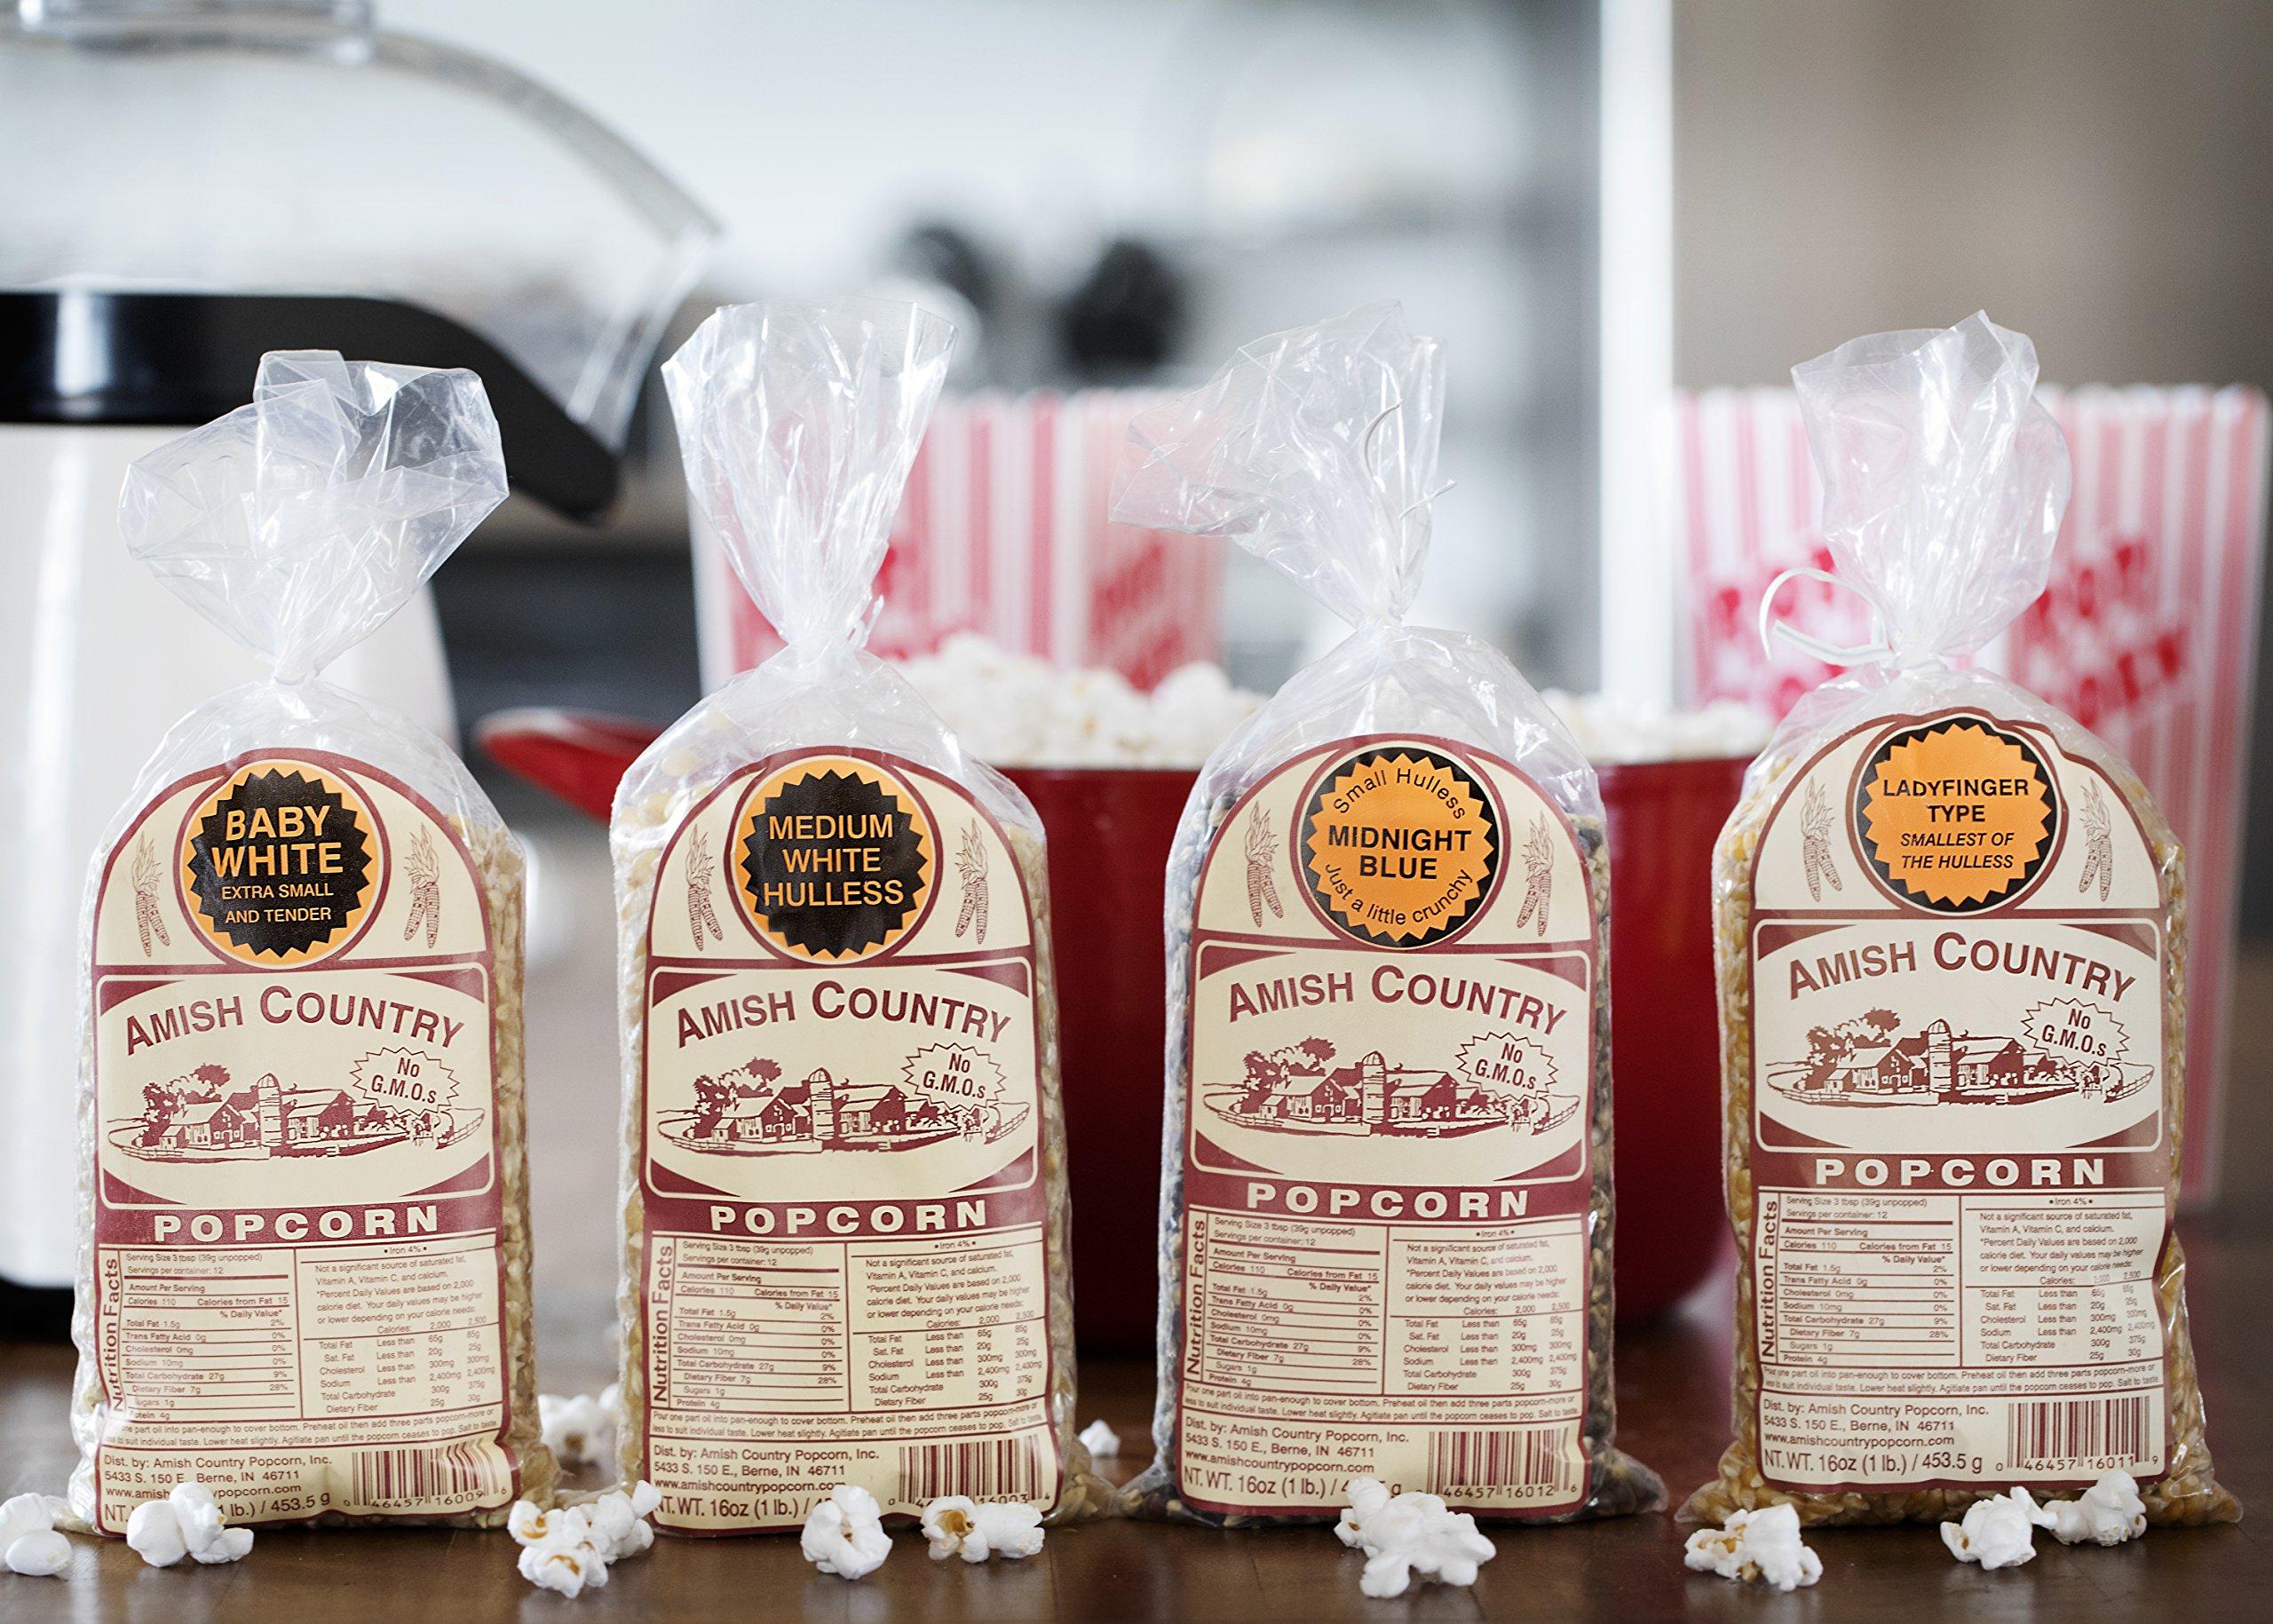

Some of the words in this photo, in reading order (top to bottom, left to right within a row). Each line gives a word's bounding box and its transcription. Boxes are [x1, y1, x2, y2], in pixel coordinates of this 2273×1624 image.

[1334, 770, 1386, 813] Small
[1397, 768, 1465, 820] Hulless
[1883, 779, 2028, 796] LADYFINGER
[226, 805, 330, 841] BABY
[1927, 804, 1985, 822] TYPE
[769, 814, 893, 839] MEDIUM
[1328, 825, 1471, 852] MIDNIGHT
[1900, 832, 1987, 847] SMALLEST
[1992, 832, 2015, 846] OF
[211, 842, 344, 877] WHITE
[782, 848, 881, 873] WHITE
[1359, 855, 1437, 879] BLUE
[1902, 855, 1934, 869] THE
[1938, 854, 2014, 869] HULLESS
[223, 885, 274, 900] EXTRA
[279, 883, 334, 898] SMALL
[764, 880, 904, 907] HULLESS
[1326, 864, 1353, 900] Just
[1351, 899, 1363, 912] a
[1367, 904, 1406, 924] little
[1413, 869, 1473, 923] crunchy
[226, 910, 259, 923] AND
[264, 907, 331, 923] TENDER
[1790, 940, 1916, 1001] AMISH
[1934, 932, 2136, 1002] COUNTRY
[1230, 971, 1353, 1023] AMISH
[1372, 965, 1567, 1035] COUNTRY
[126, 995, 243, 1056] AMISH
[260, 986, 464, 1049] COUNTRY
[678, 990, 796, 1049] AMISH
[812, 980, 1011, 1043] COUNTRY
[2068, 1009, 2091, 1030] No
[1501, 1042, 1523, 1064] No
[2042, 1026, 2107, 1058] G.M.O.s
[397, 1058, 419, 1078] No
[949, 1053, 970, 1073] No
[1476, 1059, 1536, 1089] G.M.O.s
[371, 1075, 437, 1105] G.M.O.s
[923, 1071, 986, 1099] G.M.O.s
[1816, 1158, 2104, 1185] POPCORN
[1247, 1183, 1528, 1217] POPCORN
[154, 1205, 438, 1241] POPCORN
[710, 1200, 986, 1234] POPCORN
[2083, 1224, 2114, 1233] calcium.
[1759, 1200, 1777, 1259] Facts
[126, 1254, 154, 1264] Serving
[178, 1254, 195, 1264] tbsp
[199, 1254, 216, 1263] (39g
[218, 1253, 262, 1263] unpopped)
[1190, 1220, 1205, 1279] Facts
[652, 1246, 672, 1303] Facts
[104, 1259, 120, 1316] Facts
[1761, 1265, 1775, 1357] Nutrition
[926, 1333, 943, 1342] Less
[1187, 1285, 1203, 1374] Nutrition
[1211, 1335, 1228, 1343] Total
[1232, 1337, 1287, 1350] Carbohydrate
[1293, 1343, 1309, 1351] 27g
[104, 1322, 123, 1412] Nutrition
[653, 1310, 668, 1402] Nutrition
[1764, 1398, 1784, 1411] Dist.
[1788, 1402, 1804, 1415] by:
[1809, 1404, 1846, 1415] Amish
[1850, 1405, 1900, 1418] Country
[1905, 1405, 1961, 1417] Popcorn,
[1967, 1405, 1989, 1415] Inc.
[1186, 1416, 1206, 1430] Dist.
[1210, 1421, 1226, 1434] by:
[1231, 1424, 1268, 1438] Amish
[1272, 1427, 1320, 1442] Country
[1327, 1430, 1382, 1443] Popcorn,
[1387, 1432, 1409, 1442] Inc.
[1763, 1415, 1786, 1428] 5433
[1790, 1419, 1801, 1430] S.
[1806, 1420, 1826, 1430] 150
[1850, 1421, 1891, 1433] Berne,
[1896, 1421, 1908, 1431] IN
[1918, 1421, 1953, 1431] 46711
[1185, 1432, 1208, 1446] 5433
[1212, 1438, 1222, 1449] S.
[1227, 1440, 1247, 1452] 150
[1271, 1446, 1311, 1457] Berne,
[1316, 1446, 1329, 1456] IN
[1337, 1447, 1374, 1458] 46711
[1764, 1432, 1954, 1449] www.amishcountrypopcorn.com
[105, 1455, 128, 1467] Dist.
[132, 1458, 149, 1470] by:
[154, 1458, 191, 1468] Amish
[195, 1457, 244, 1471] Country
[249, 1456, 305, 1471] Popcorn,
[310, 1455, 332, 1465] Inc.
[654, 1446, 674, 1456] Dist.
[680, 1448, 697, 1460] by:
[701, 1448, 737, 1460] Amish
[742, 1449, 790, 1462] Country
[796, 1450, 851, 1462] Popcorn,
[857, 1449, 879, 1460] Inc.
[1185, 1449, 1374, 1473] www.amishcountrypopcorn.com
[1819, 1454, 1857, 1472] 16oz
[1882, 1454, 1906, 1476] lb.)
[1922, 1452, 1966, 1470] 453.5
[1972, 1456, 1982, 1474] g
[2024, 1459, 2076, 1470] 46457
[2087, 1455, 2134, 1470] 16011
[105, 1471, 131, 1482] 5433
[135, 1473, 147, 1483] S.
[152, 1474, 172, 1484] 150
[197, 1473, 237, 1484] Berne,
[242, 1470, 254, 1481] IN
[263, 1470, 299, 1480] 46711
[654, 1462, 678, 1473] 5433
[682, 1464, 693, 1474] S.
[698, 1465, 717, 1475] 150
[742, 1466, 781, 1477] Berne,
[787, 1466, 799, 1476] IN
[808, 1465, 844, 1476] 46711
[107, 1484, 301, 1499] www.amishpopcorn.com
[654, 1479, 846, 1494] www.amishcountrypopcorn.co
[1239, 1475, 1276, 1494] 16oz
[1301, 1477, 1326, 1499] lb.)
[1444, 1486, 1495, 1499] 46457
[1506, 1485, 1554, 1499] 16012
[231, 1504, 256, 1517] lb.)
[271, 1495, 314, 1511] 453.5
[321, 1493, 329, 1506] g
[710, 1498, 748, 1517] 16oz
[773, 1499, 798, 1518] lb.)
